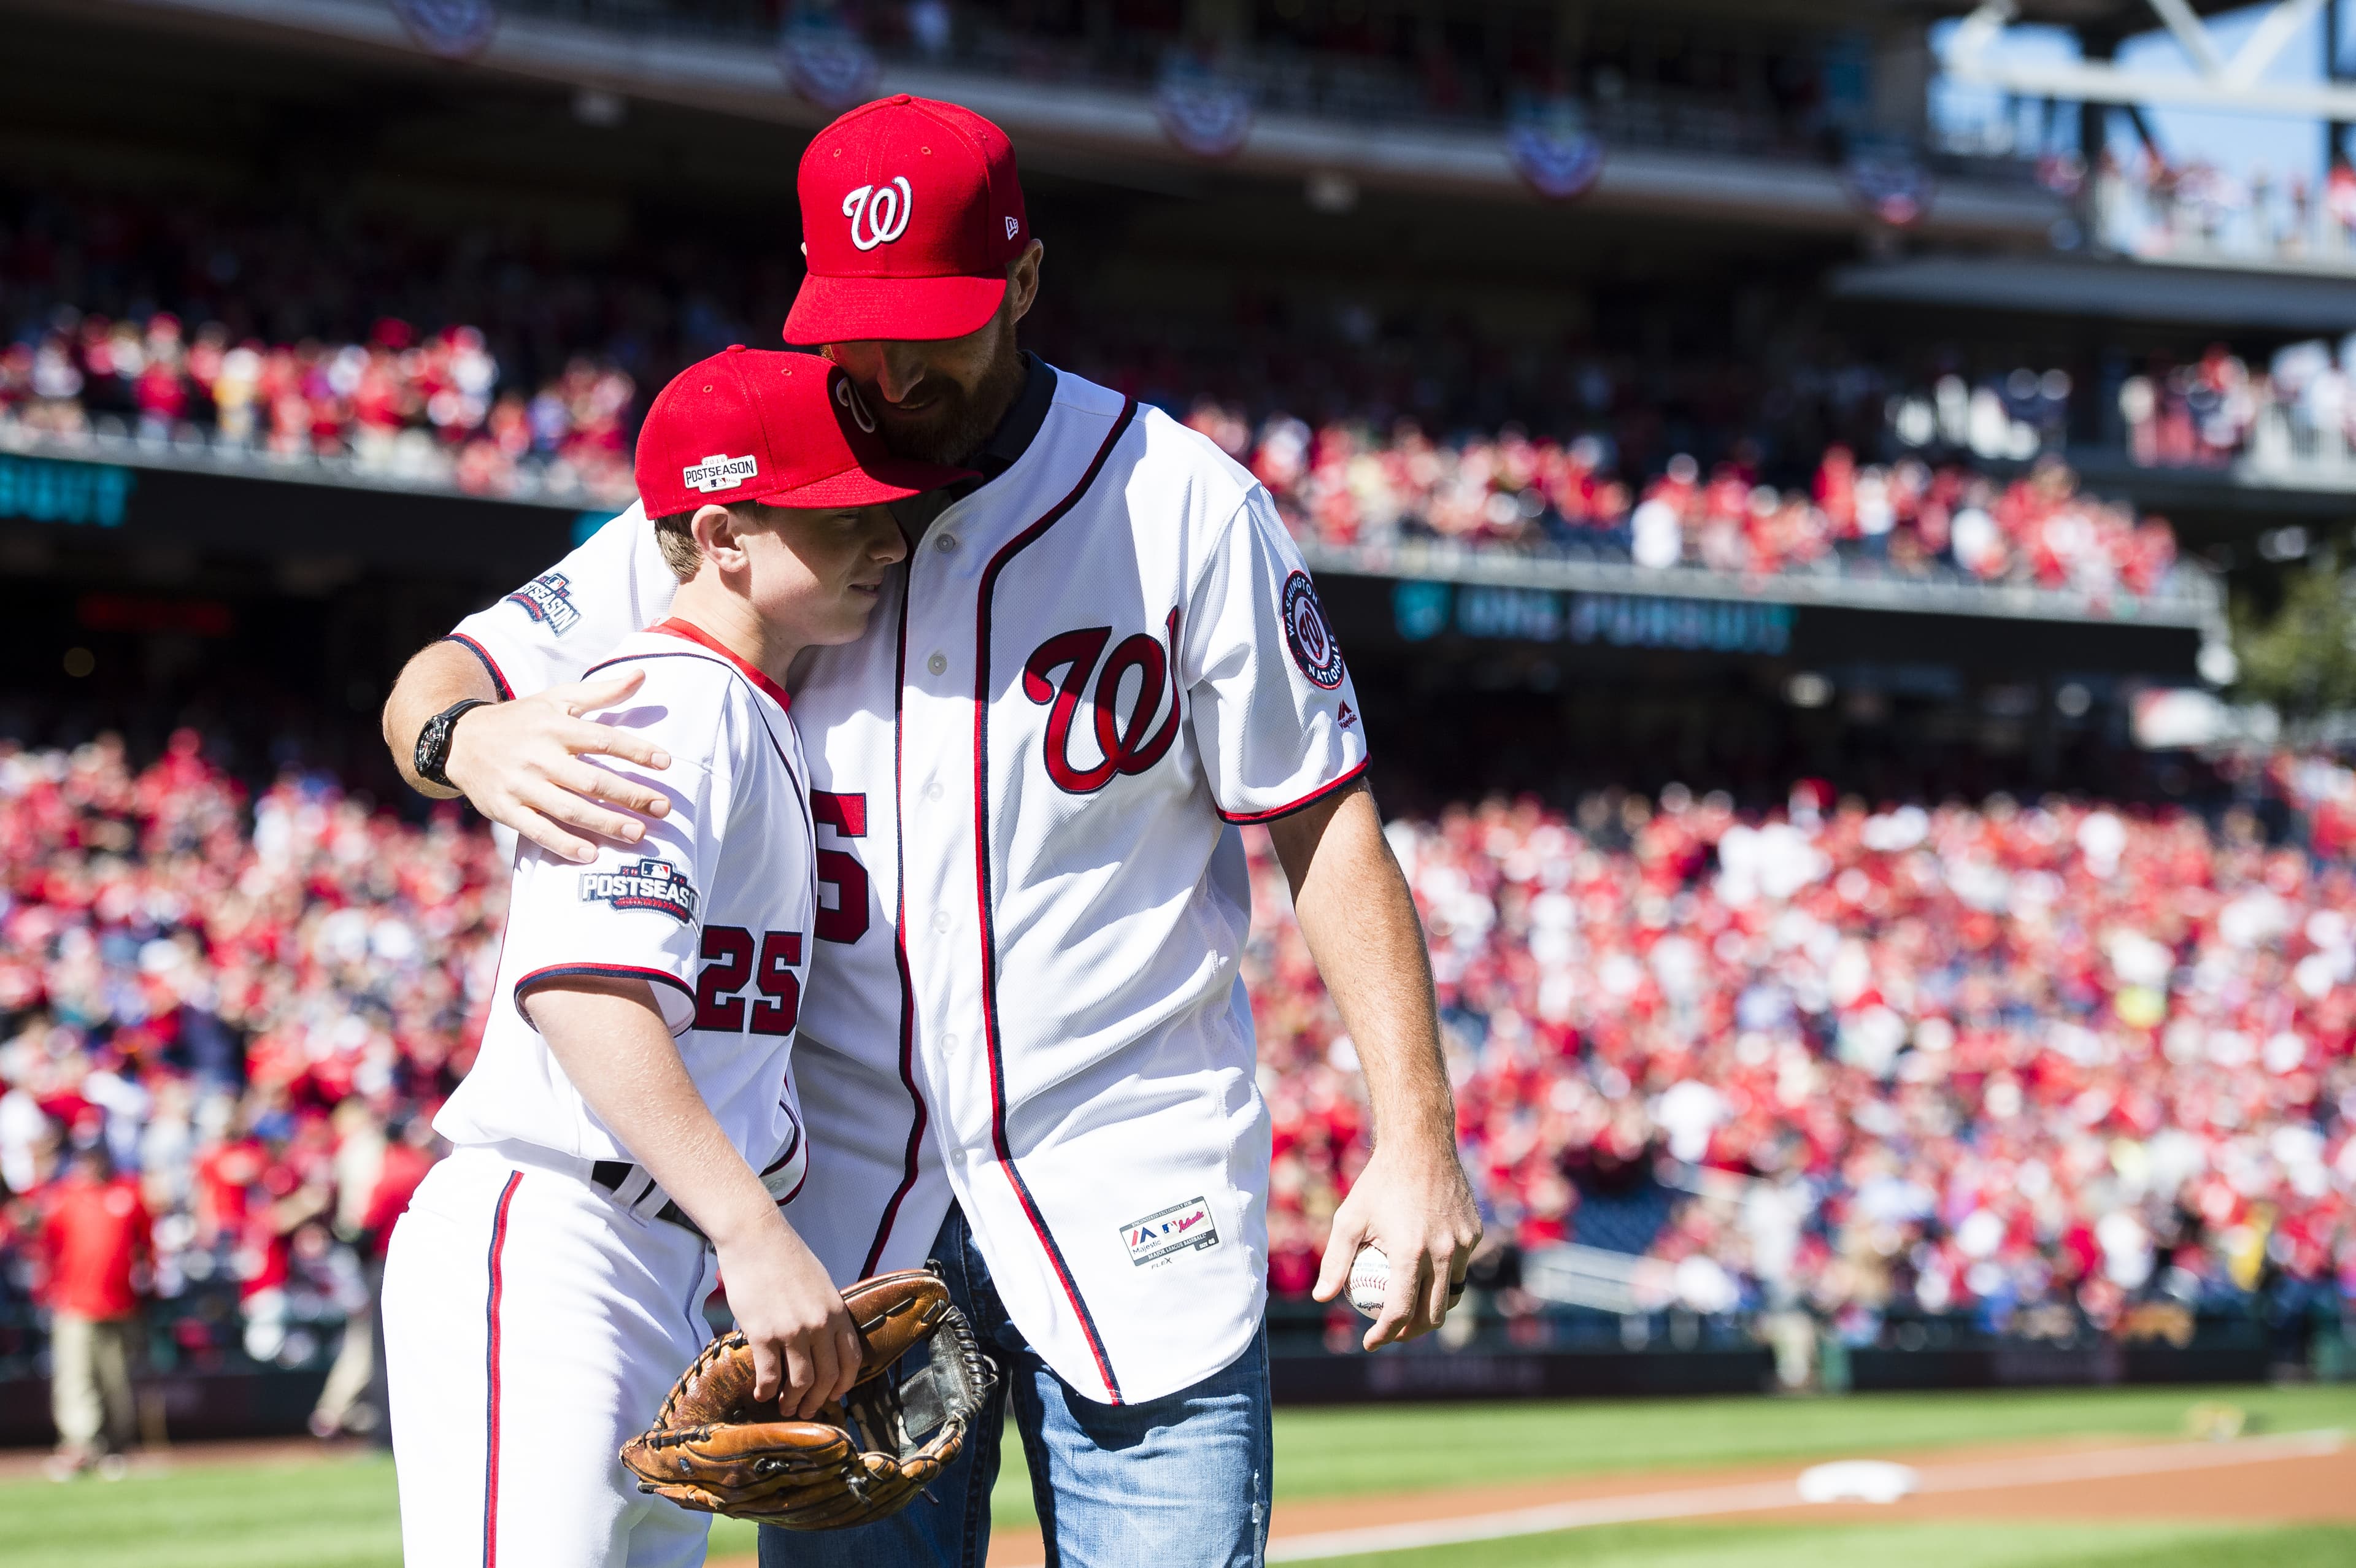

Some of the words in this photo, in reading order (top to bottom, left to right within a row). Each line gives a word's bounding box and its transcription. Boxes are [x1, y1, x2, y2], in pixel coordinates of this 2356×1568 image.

[842, 176, 913, 252] W
[685, 460, 755, 485] POSTSEASON
[1285, 576, 1318, 636] WASHINGTON
[1307, 634, 1342, 684] NATIONALS
[1022, 605, 1181, 795] W
[691, 924, 803, 1036] 25
[1133, 1239, 1161, 1255] Majestic
[1147, 1250, 1166, 1260] MAJOR
[1166, 1242, 1184, 1253] LEAGUE
